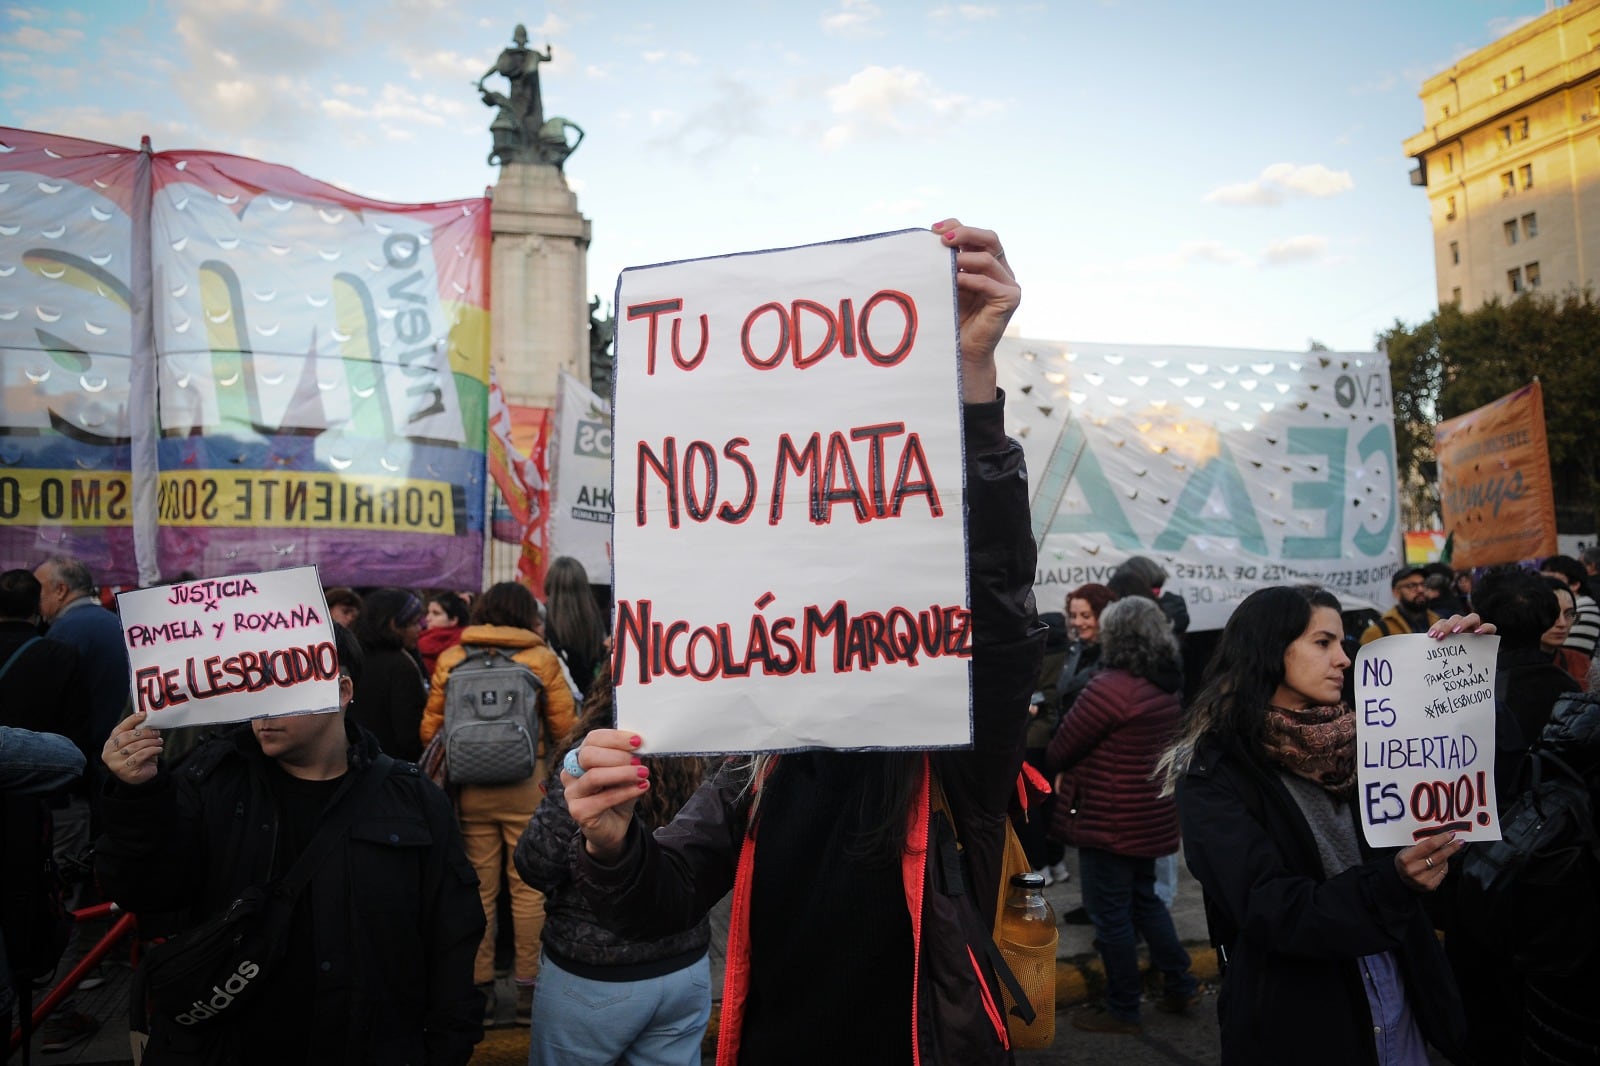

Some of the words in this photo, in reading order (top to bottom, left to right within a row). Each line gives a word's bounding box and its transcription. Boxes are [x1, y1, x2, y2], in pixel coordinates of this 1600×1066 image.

[627, 298, 709, 375] TU
[741, 290, 917, 371] ODIO
[637, 436, 758, 529] NOS
[769, 422, 943, 525] MATA
[169, 579, 257, 605] JUSTICIA
[127, 620, 203, 647] PAMELA
[234, 604, 323, 633] ROXANA
[612, 591, 802, 686] NICOLÁS
[801, 600, 973, 674] MARQUEZ
[136, 666, 190, 713] FUE
[1362, 657, 1393, 687] NO
[1424, 667, 1465, 687] PAMELA
[1364, 698, 1396, 728] ES
[1364, 735, 1478, 770] LIBERTAD
[1365, 781, 1406, 825] ES
[1410, 770, 1491, 826] ODIO!
[175, 960, 260, 1025] adidas
